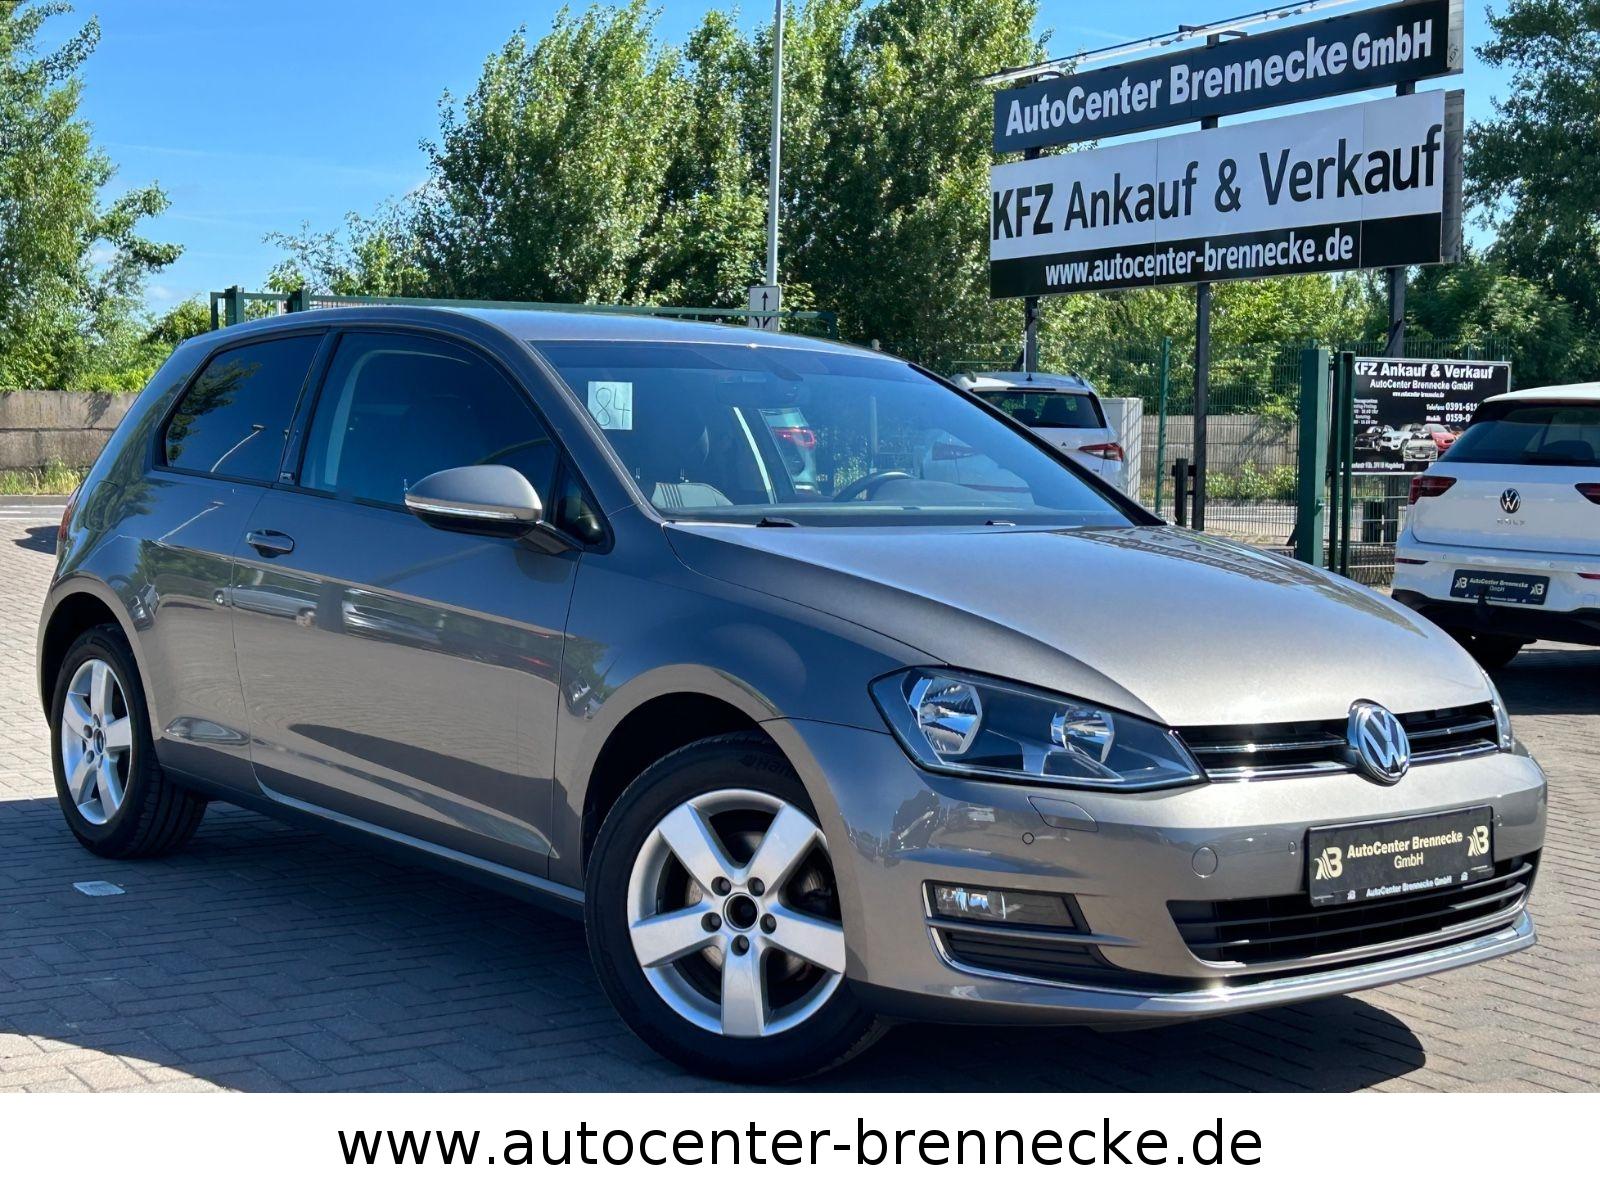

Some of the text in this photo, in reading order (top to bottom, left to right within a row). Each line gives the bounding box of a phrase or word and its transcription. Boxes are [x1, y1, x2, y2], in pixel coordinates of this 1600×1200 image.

[1005, 19, 1433, 137] AutoCenter Brennecke GmbH
[992, 124, 1443, 241] KFZ Ankauf & Verkauf
[1045, 227, 1354, 286] www.autocenter-brennecke.de
[1380, 363, 1427, 377] Ankauf
[1430, 364, 1441, 378] &
[1444, 365, 1494, 379] Verkauf
[1370, 379, 1474, 390] AutoCenter Brennecke GmbH
[595, 387, 631, 428] 84
[1445, 413, 1473, 422] 0159-0
[1347, 830, 1464, 859] AutoCenter Brennecke
[1394, 852, 1424, 869] GmbH
[1366, 885, 1402, 897] AutoCenter
[1402, 879, 1434, 892] Brennecke
[1434, 875, 1452, 886] GmbH
